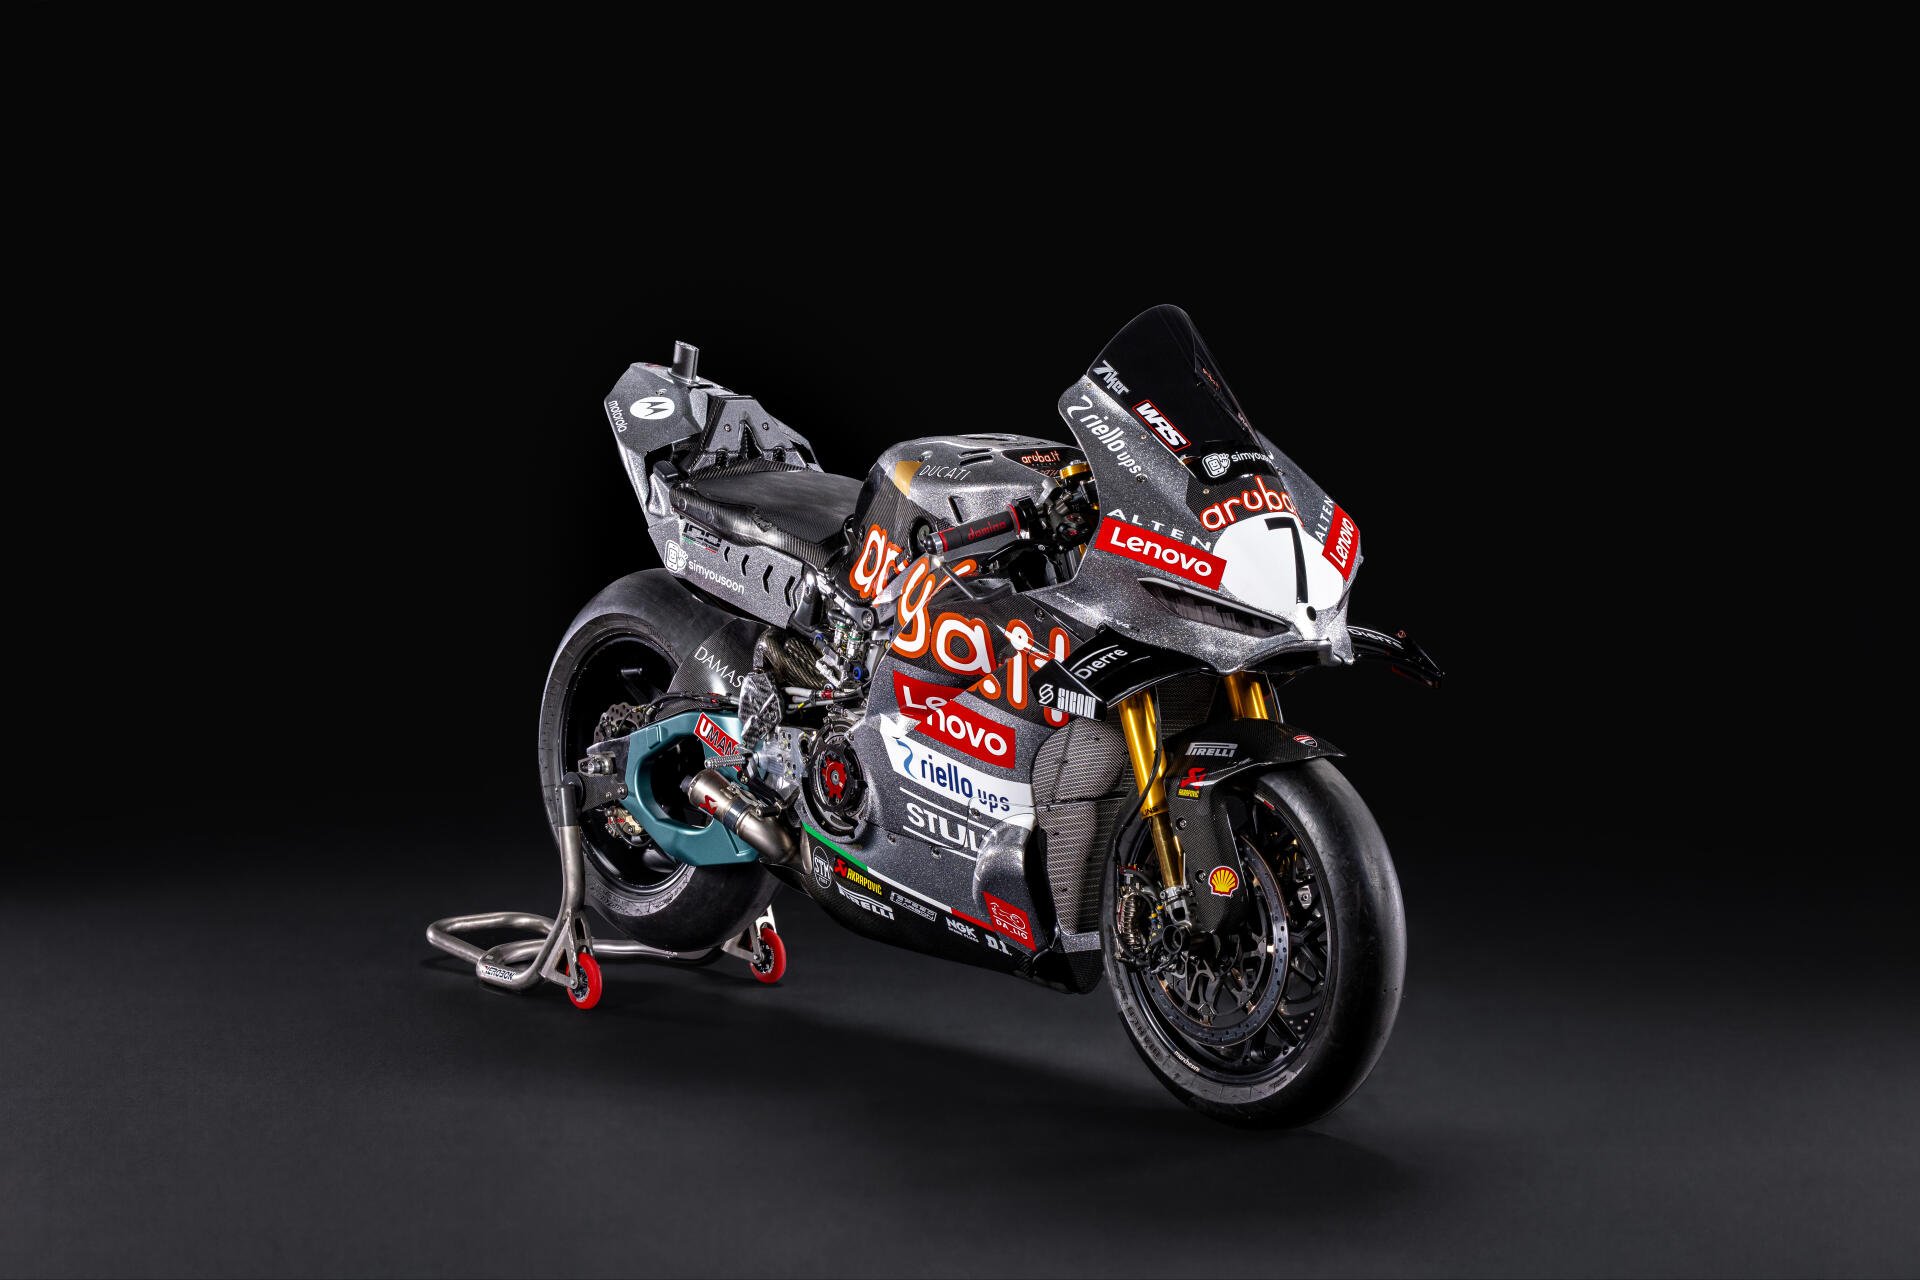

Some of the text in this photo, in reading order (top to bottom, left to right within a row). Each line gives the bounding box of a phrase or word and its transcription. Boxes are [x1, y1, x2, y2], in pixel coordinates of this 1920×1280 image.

[608, 401, 628, 432] motorola
[1136, 402, 1187, 446] WRS
[1080, 414, 1142, 474] riello ups
[919, 465, 971, 481] DUCATI
[968, 521, 1006, 540] domino
[1107, 508, 1212, 551] ALTEN
[1315, 495, 1334, 543] ALTEN
[1110, 526, 1212, 578] Lenovo
[1264, 517, 1309, 604] 7
[1329, 517, 1354, 569] Lenovo
[688, 560, 745, 595] simyousoon
[902, 684, 1008, 757] Lenovo
[1185, 742, 1238, 757] PIRELLI
[920, 754, 1010, 813] riello ups
[814, 856, 831, 880] STM
[945, 916, 977, 939] NGK
